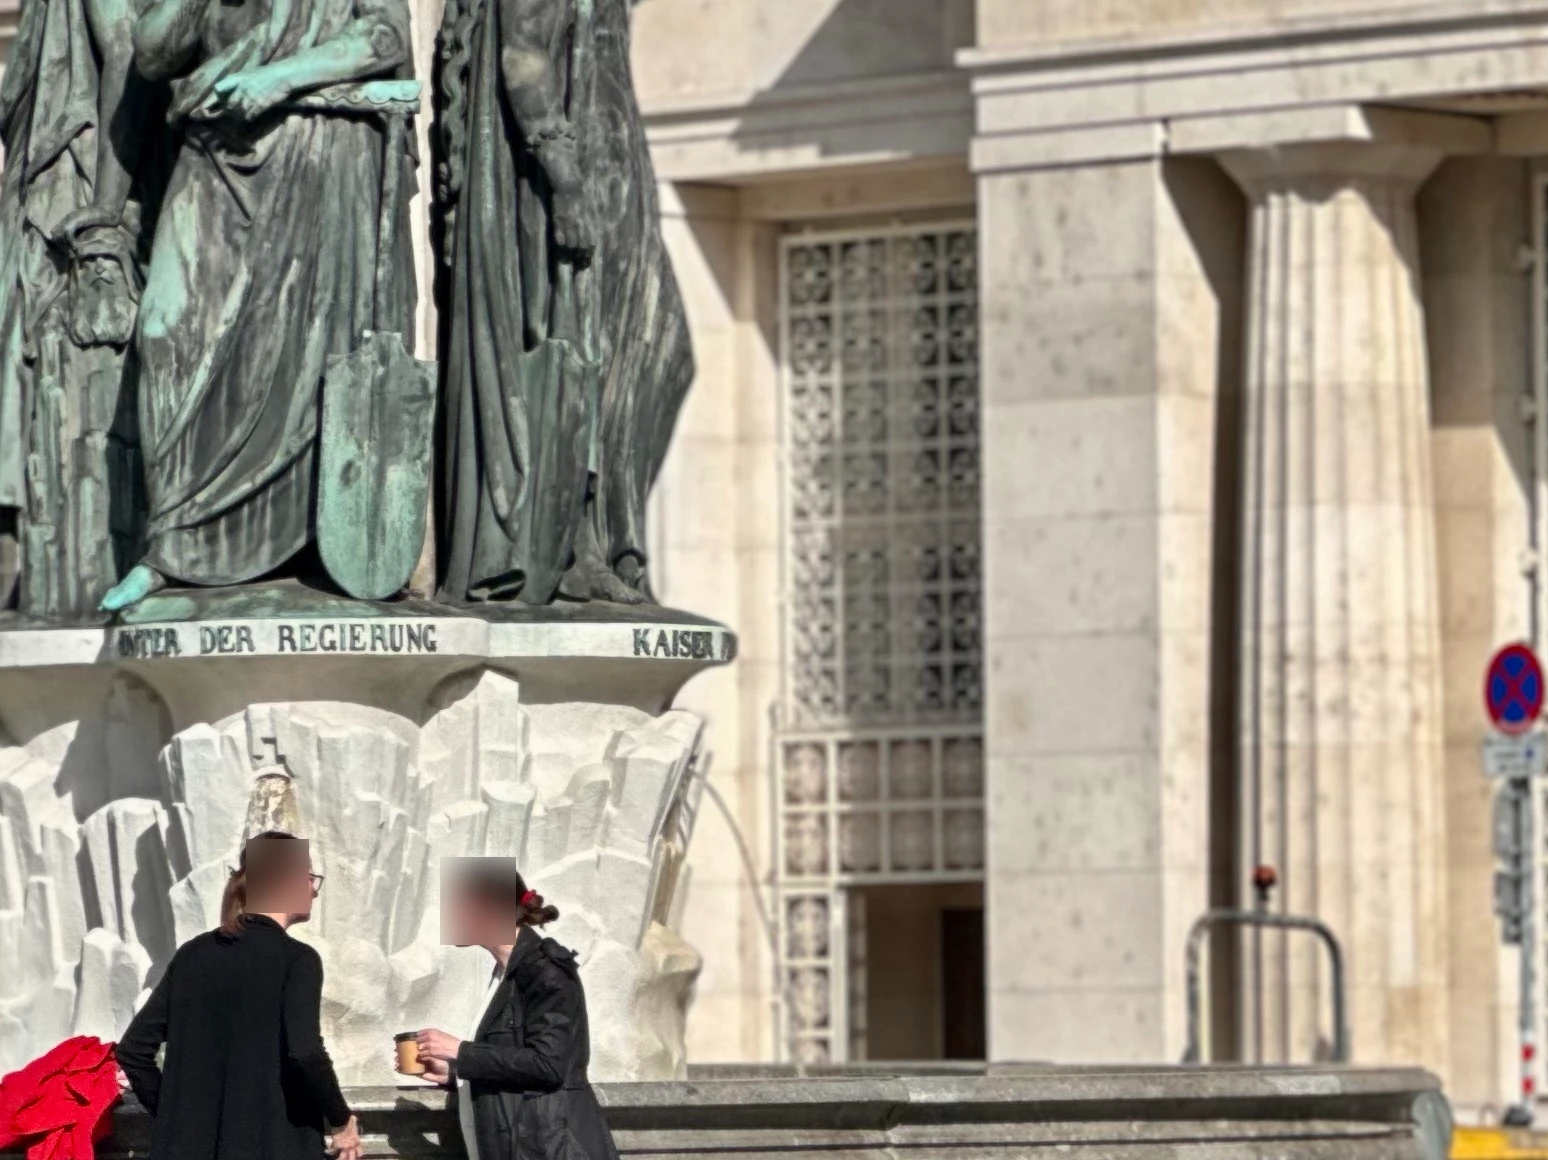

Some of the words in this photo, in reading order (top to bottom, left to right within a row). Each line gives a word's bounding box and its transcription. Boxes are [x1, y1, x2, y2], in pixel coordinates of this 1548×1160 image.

[200, 625, 256, 654] DER
[278, 623, 438, 654] REGIERUNG
[632, 628, 714, 659] KAISER
